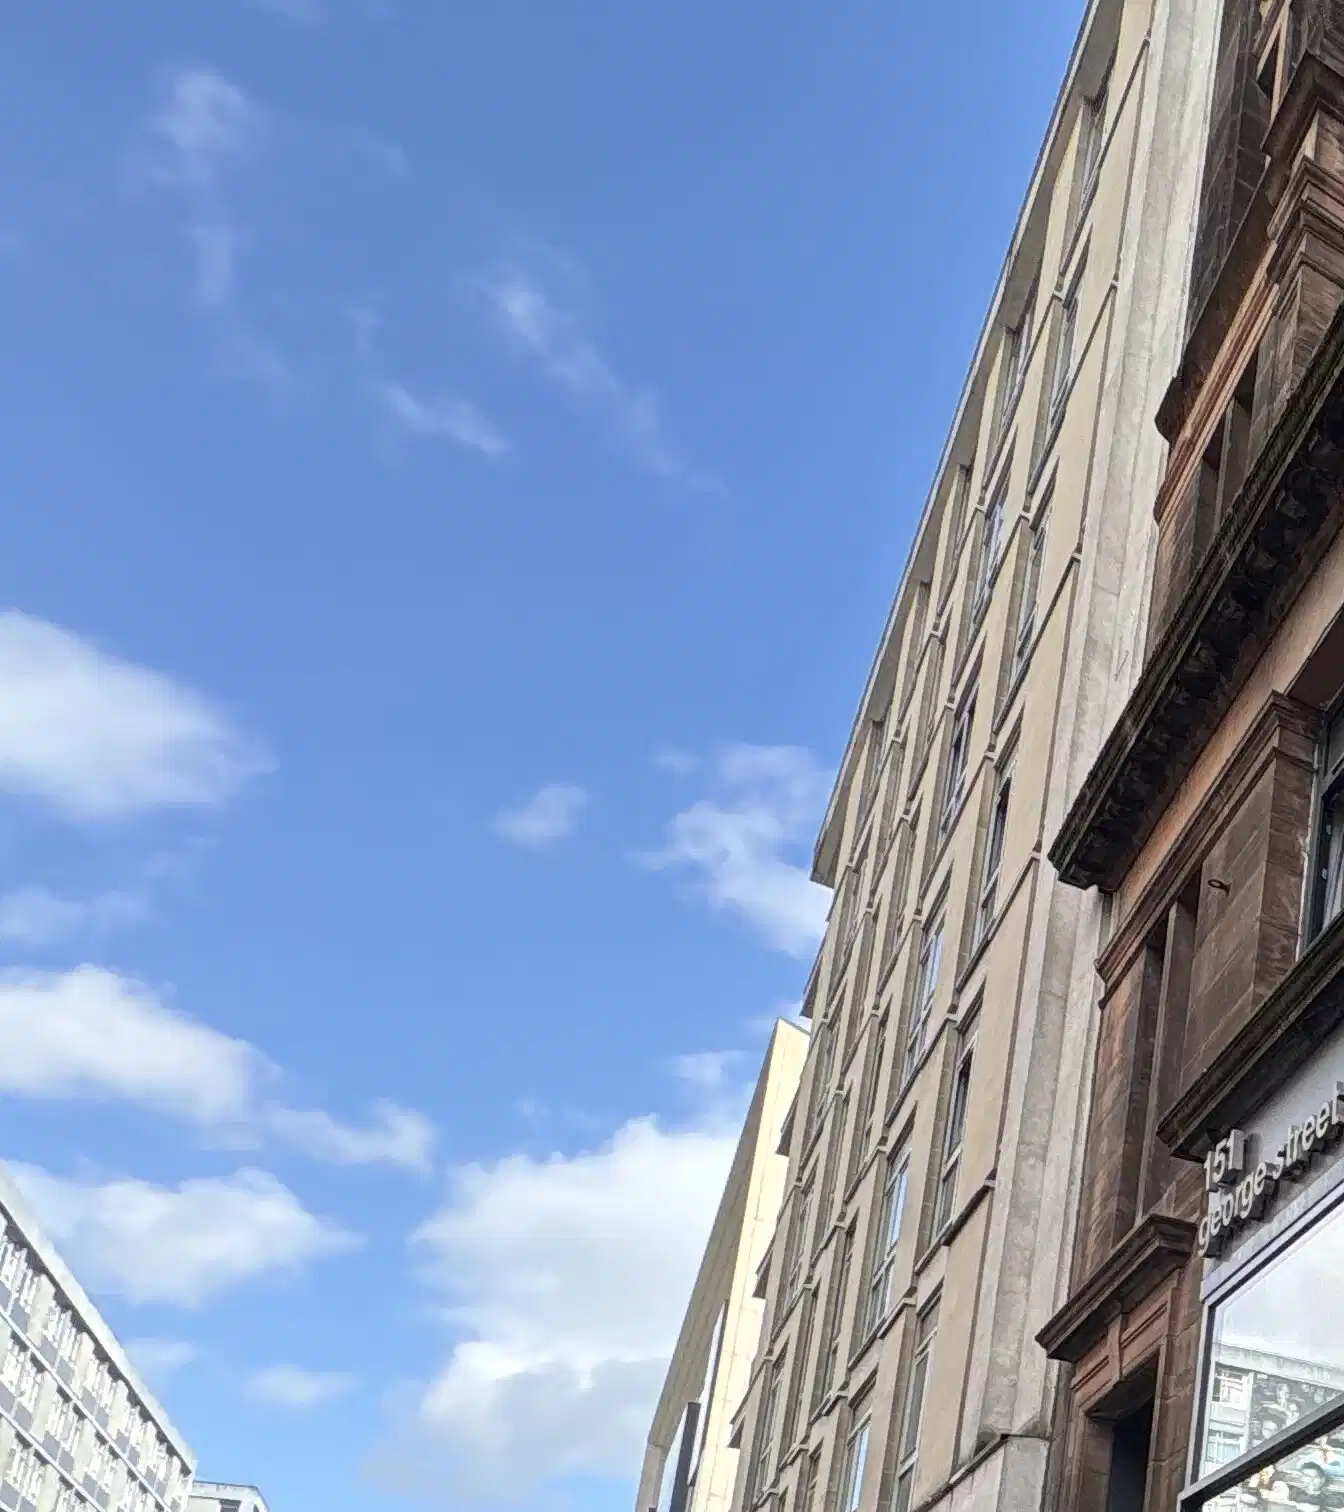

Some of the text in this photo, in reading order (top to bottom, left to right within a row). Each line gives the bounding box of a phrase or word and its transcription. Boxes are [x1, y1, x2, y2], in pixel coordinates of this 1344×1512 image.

[1198, 1162, 1267, 1257] george
[1272, 1081, 1344, 1180] street
[1204, 1129, 1243, 1190] 151
